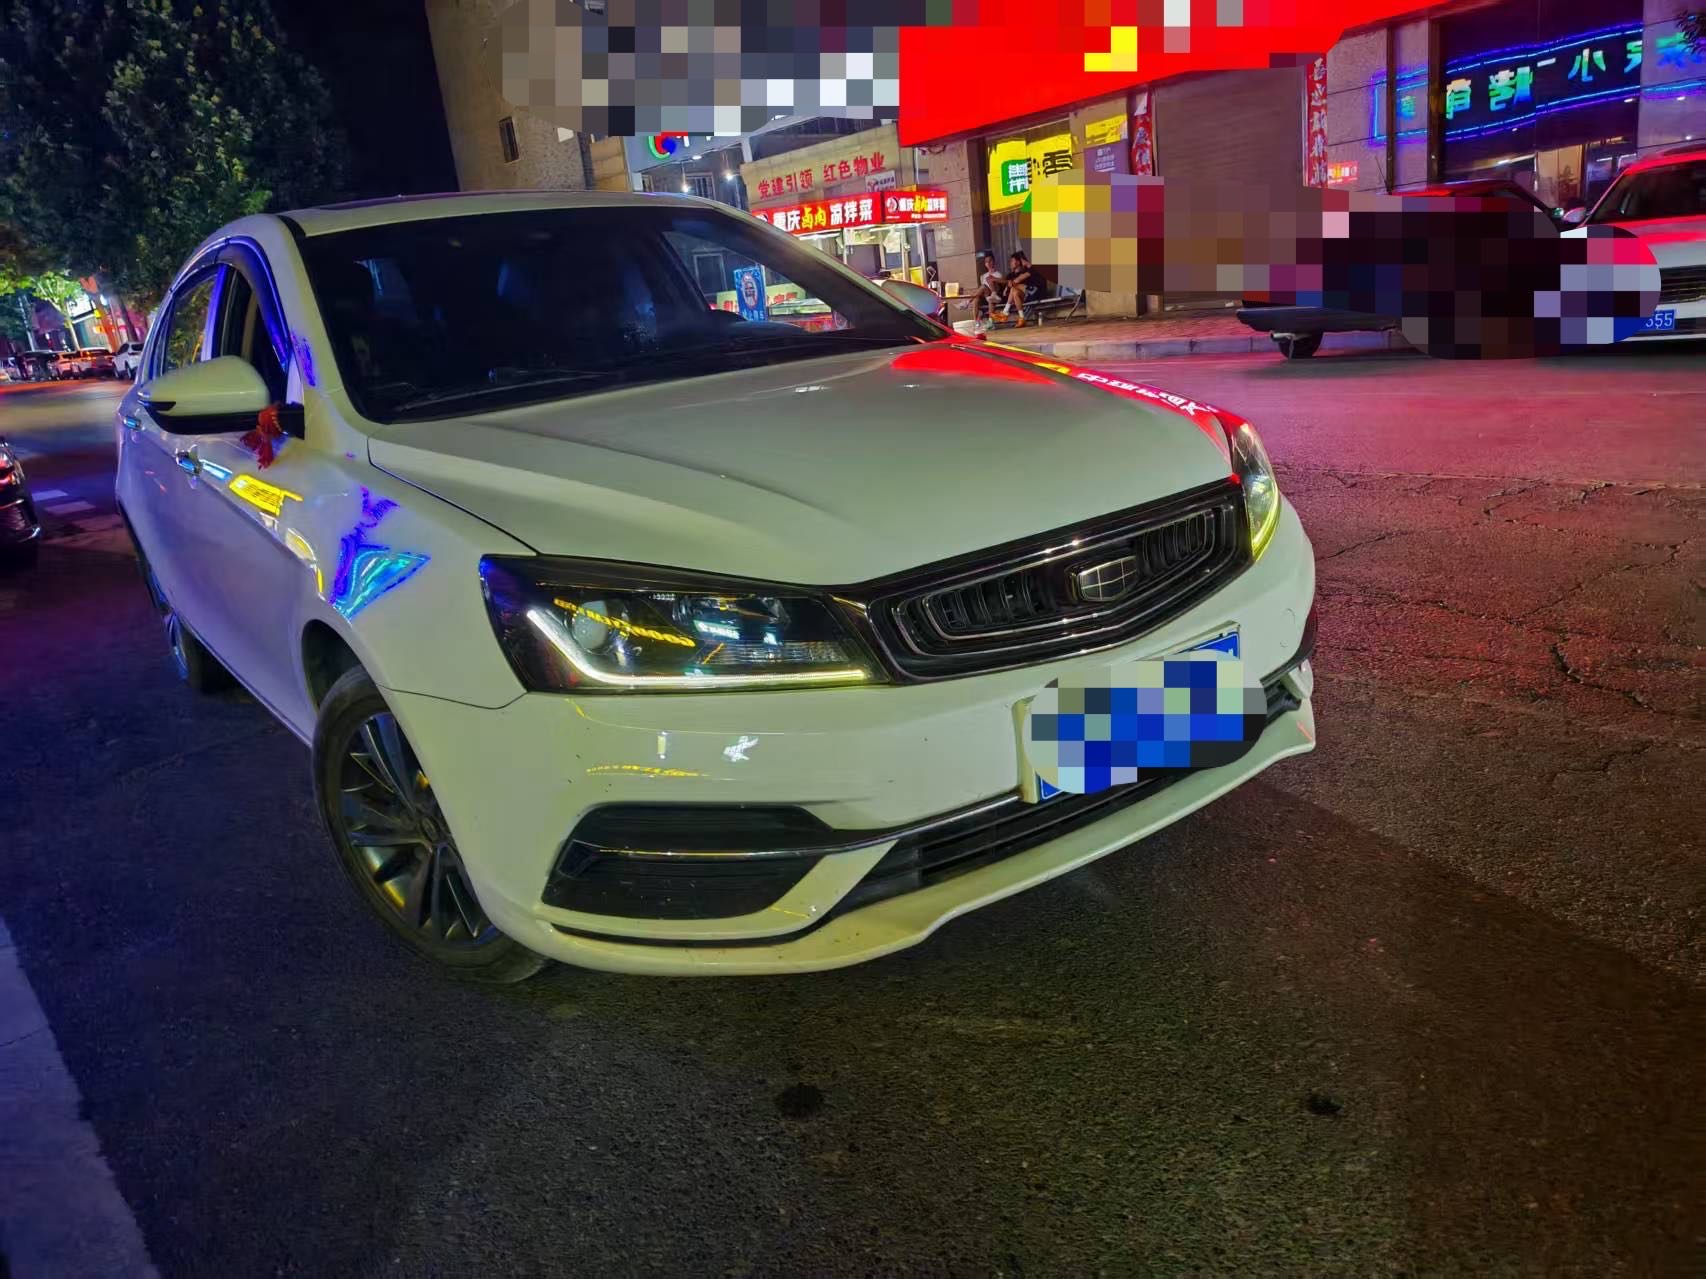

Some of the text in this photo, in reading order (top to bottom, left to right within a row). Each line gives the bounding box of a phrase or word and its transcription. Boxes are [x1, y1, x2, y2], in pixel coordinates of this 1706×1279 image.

[757, 151, 887, 200] 党建引领 红色物业
